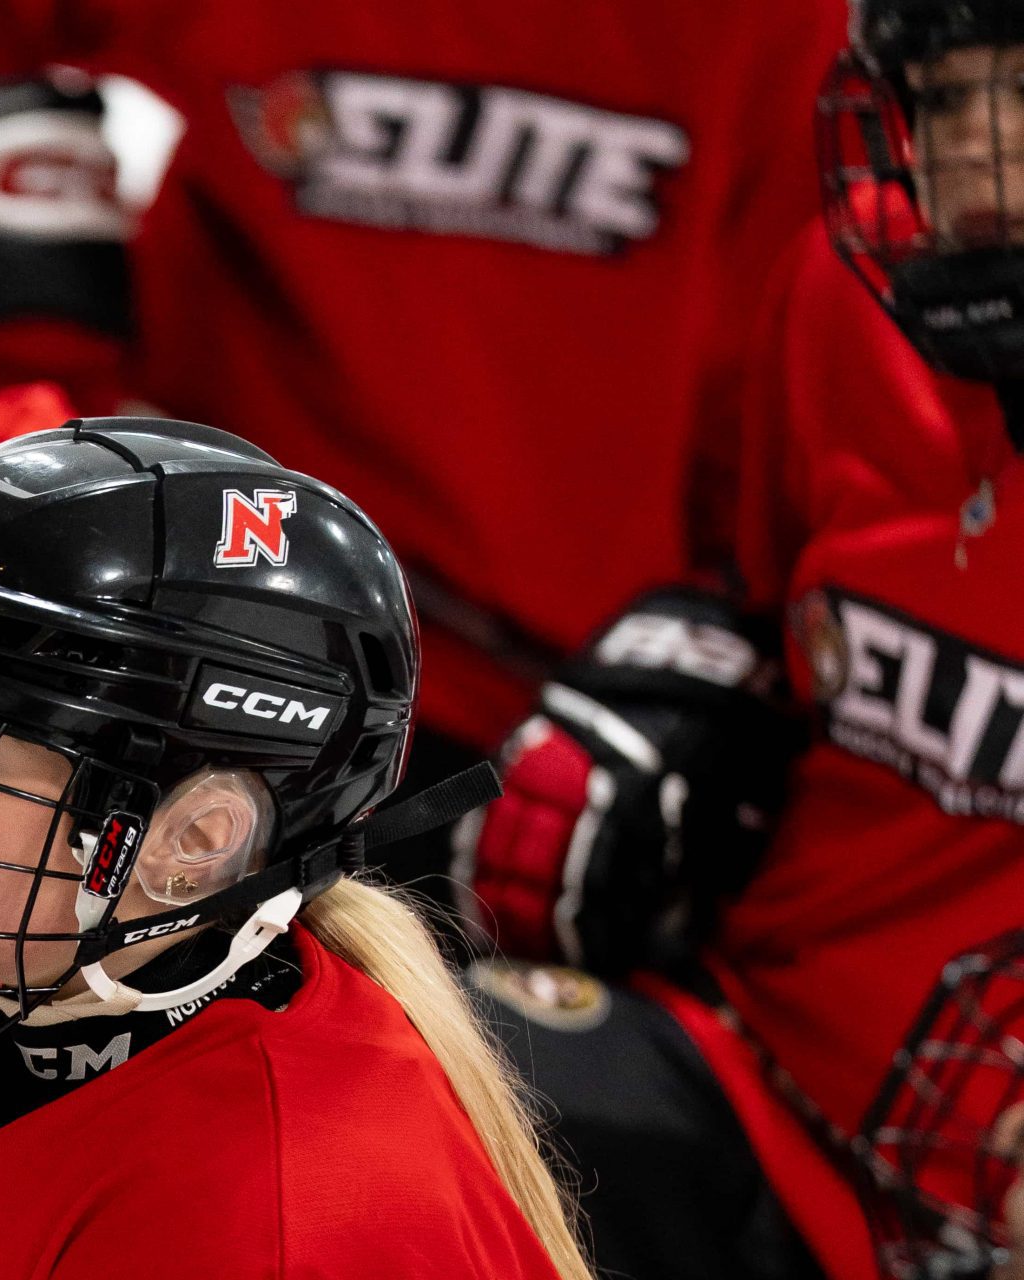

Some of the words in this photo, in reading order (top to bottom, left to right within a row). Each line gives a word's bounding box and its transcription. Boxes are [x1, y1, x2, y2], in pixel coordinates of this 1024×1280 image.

[298, 70, 691, 240] ELITE
[214, 489, 297, 568] N
[202, 682, 331, 731] CCM
[90, 818, 123, 892] CCM
[123, 913, 201, 944] CCM
